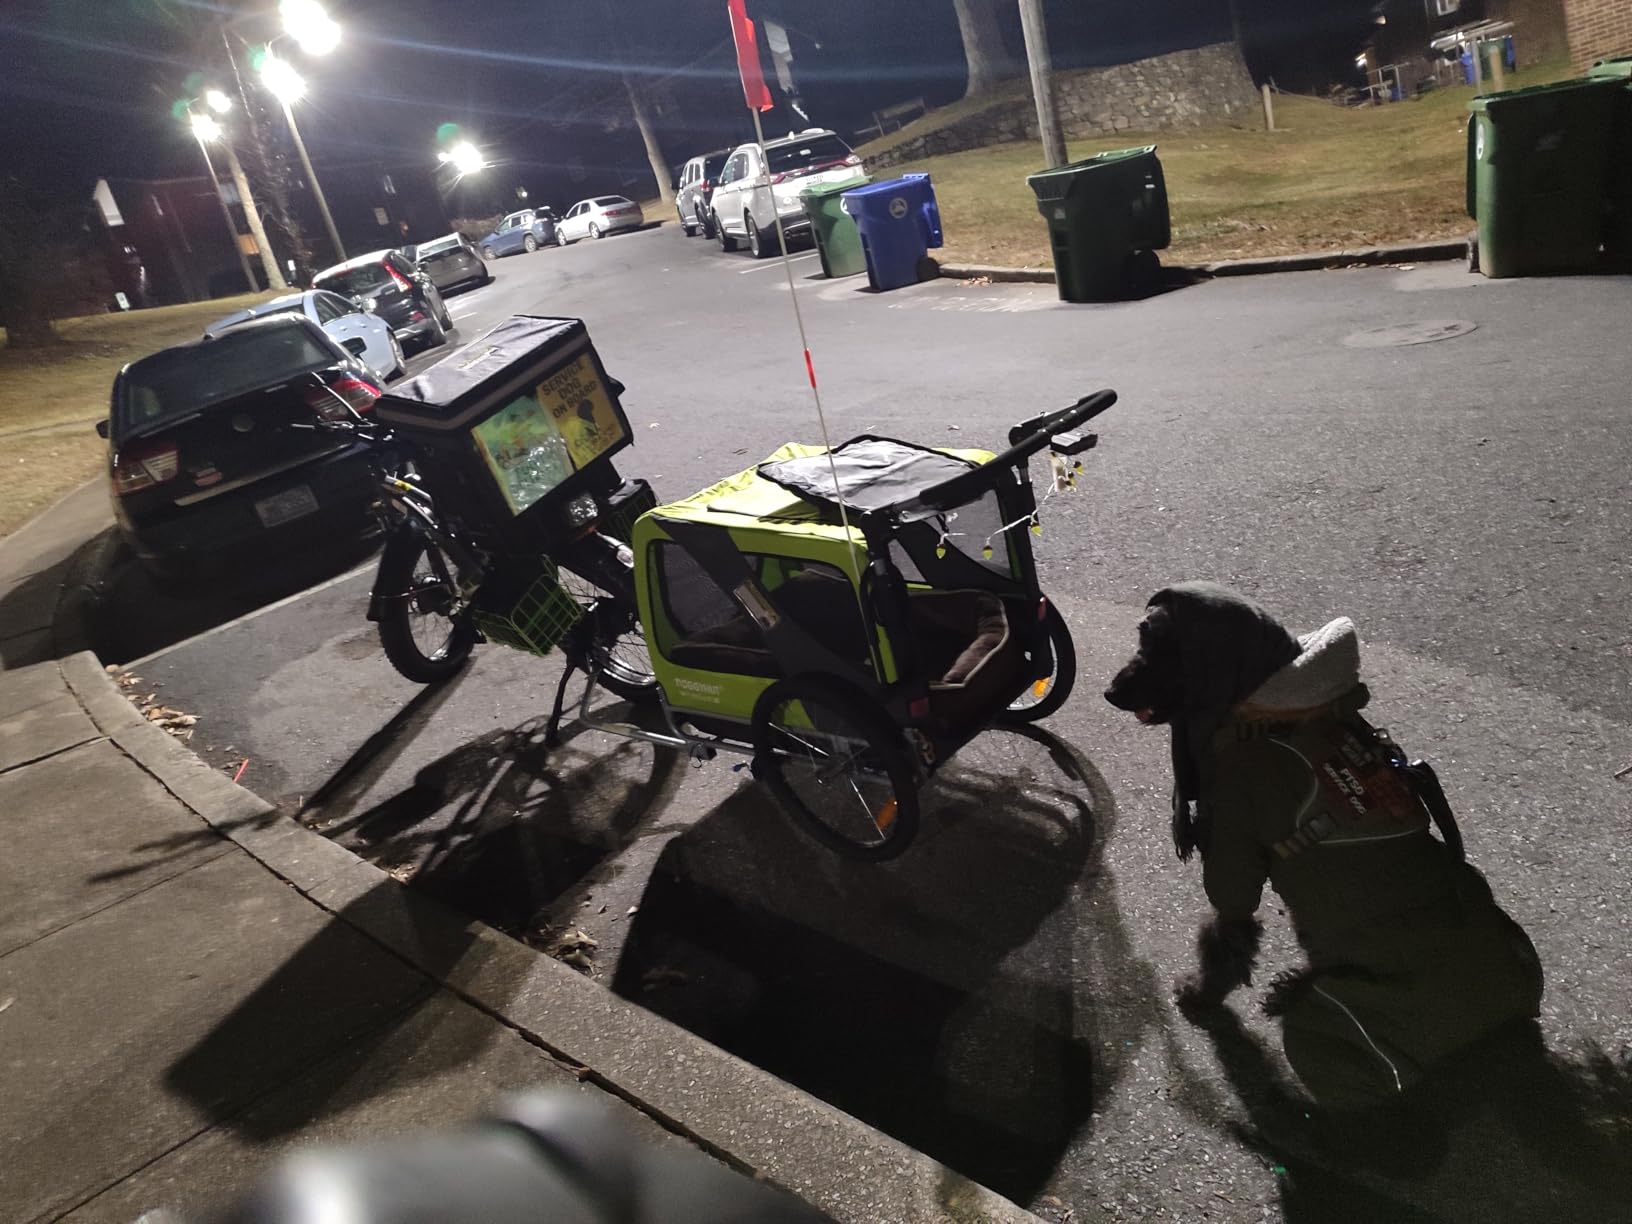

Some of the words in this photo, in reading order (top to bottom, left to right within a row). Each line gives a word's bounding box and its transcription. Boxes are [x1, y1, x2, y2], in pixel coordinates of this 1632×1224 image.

[542, 360, 584, 396] SERVICE
[558, 377, 582, 400] DOG
[552, 403, 569, 419] ON
[567, 380, 597, 409] BOARD
[1322, 762, 1351, 794] SERVICE
[1349, 796, 1367, 816] DOG
[1340, 767, 1365, 796] PTSD
